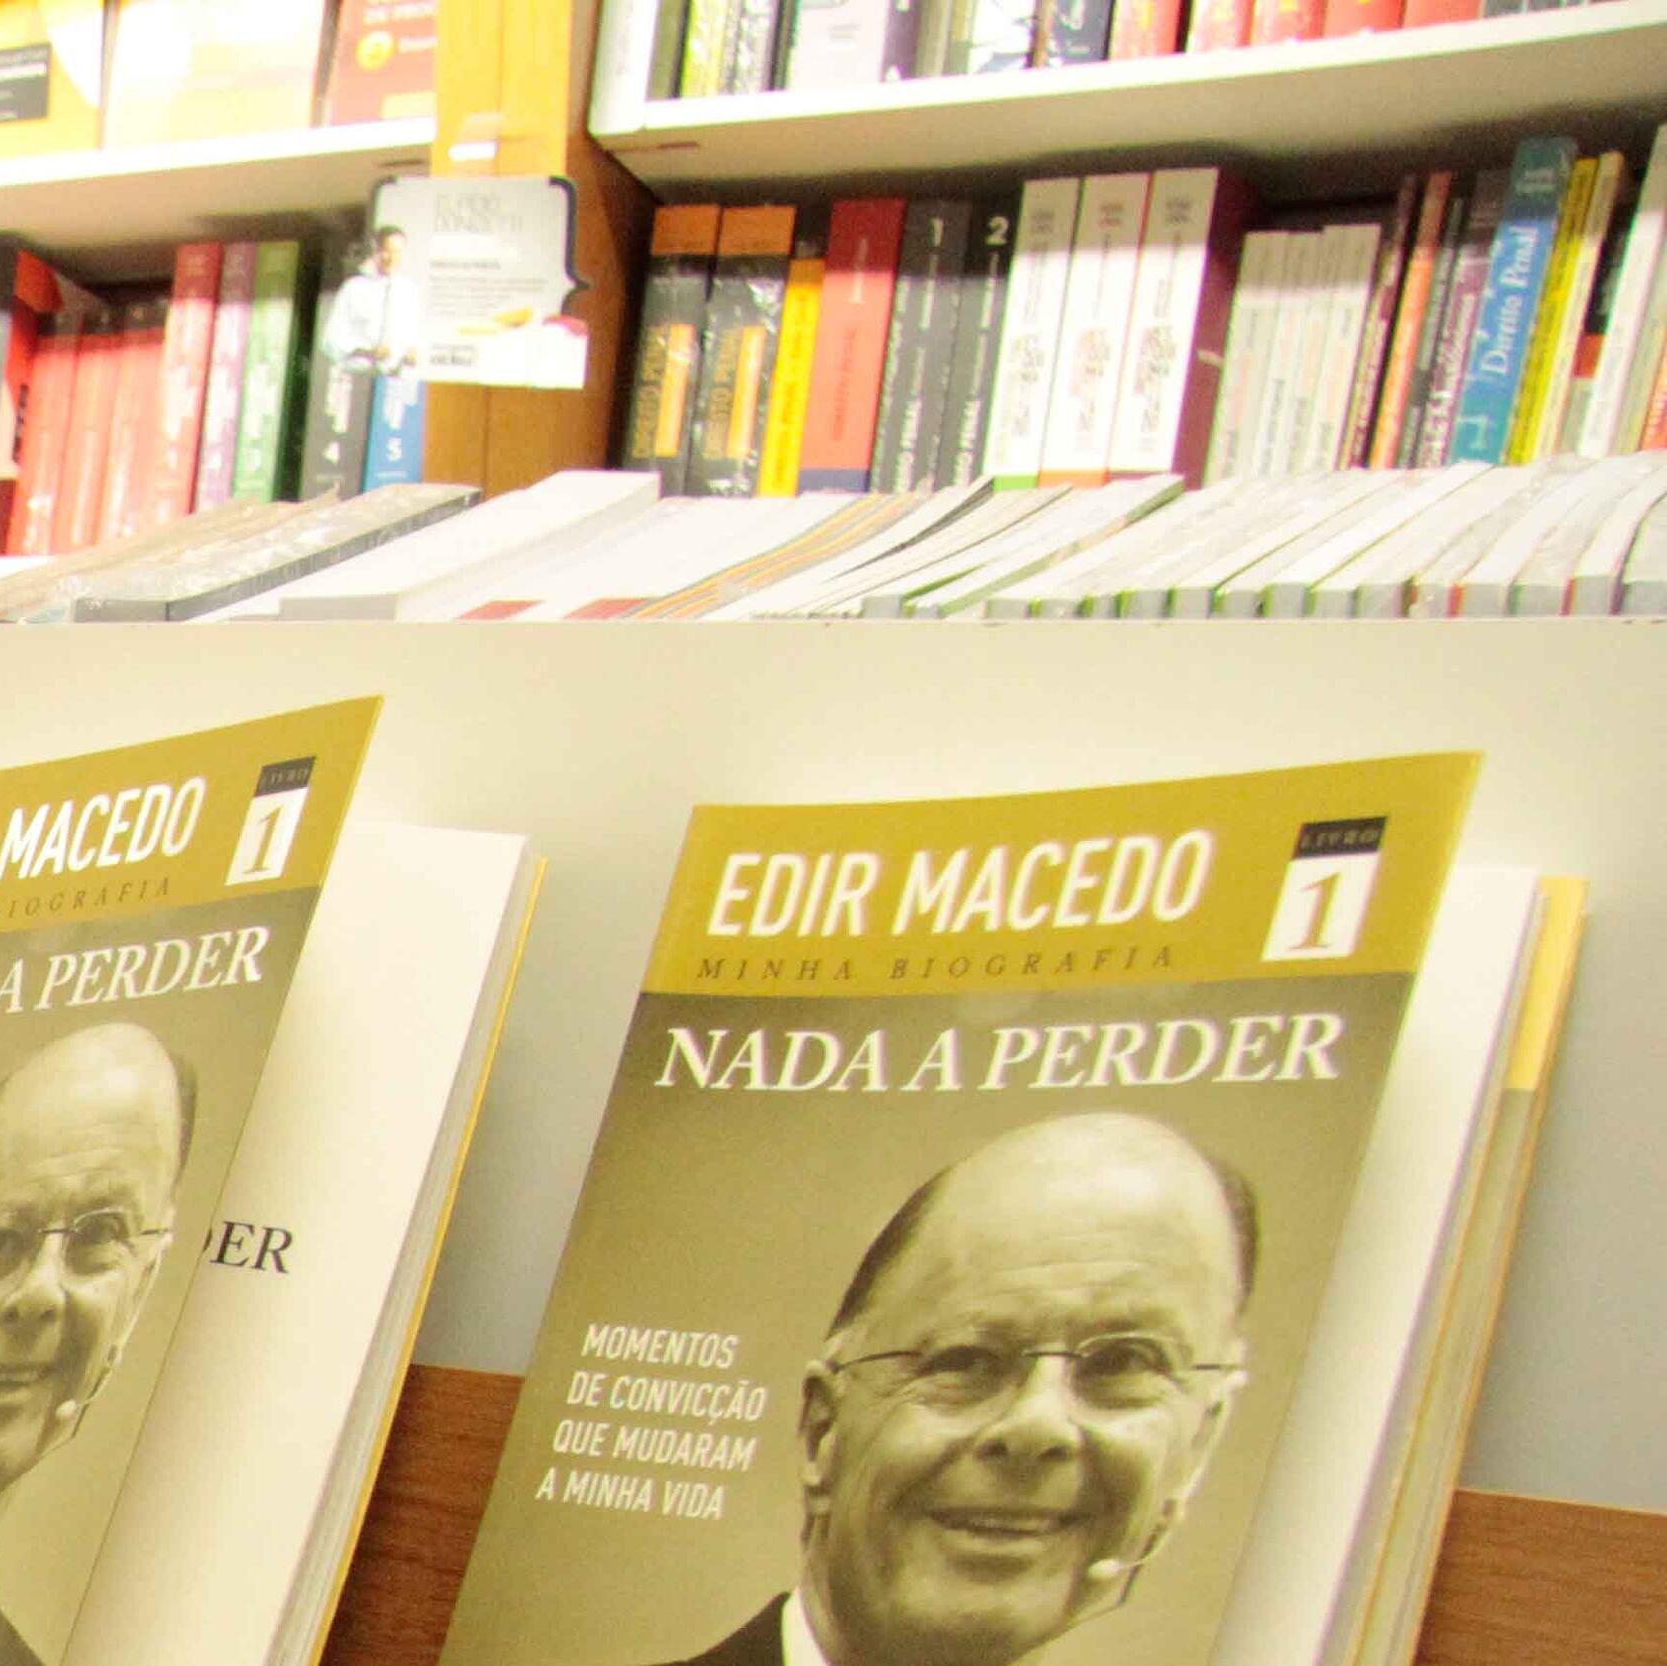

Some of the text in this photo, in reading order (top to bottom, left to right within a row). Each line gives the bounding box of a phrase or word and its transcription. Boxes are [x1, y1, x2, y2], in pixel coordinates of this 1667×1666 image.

[985, 214, 1009, 246] 2
[1480, 224, 1540, 376] Direito Penal
[243, 806, 282, 875] 1
[707, 830, 1215, 937] EDIR MACEDO
[1289, 872, 1344, 950] 1
[36, 926, 270, 1012] PERDER
[696, 945, 1175, 982] MINHA BIOGRAFIA
[655, 1012, 1345, 1093] NADA A PERDER
[581, 1323, 740, 1369] MOMENTOS
[567, 1370, 607, 1406] DE
[553, 1418, 758, 1472] QUE MUDARAM
[535, 1466, 726, 1520] A MINHA VIDA
